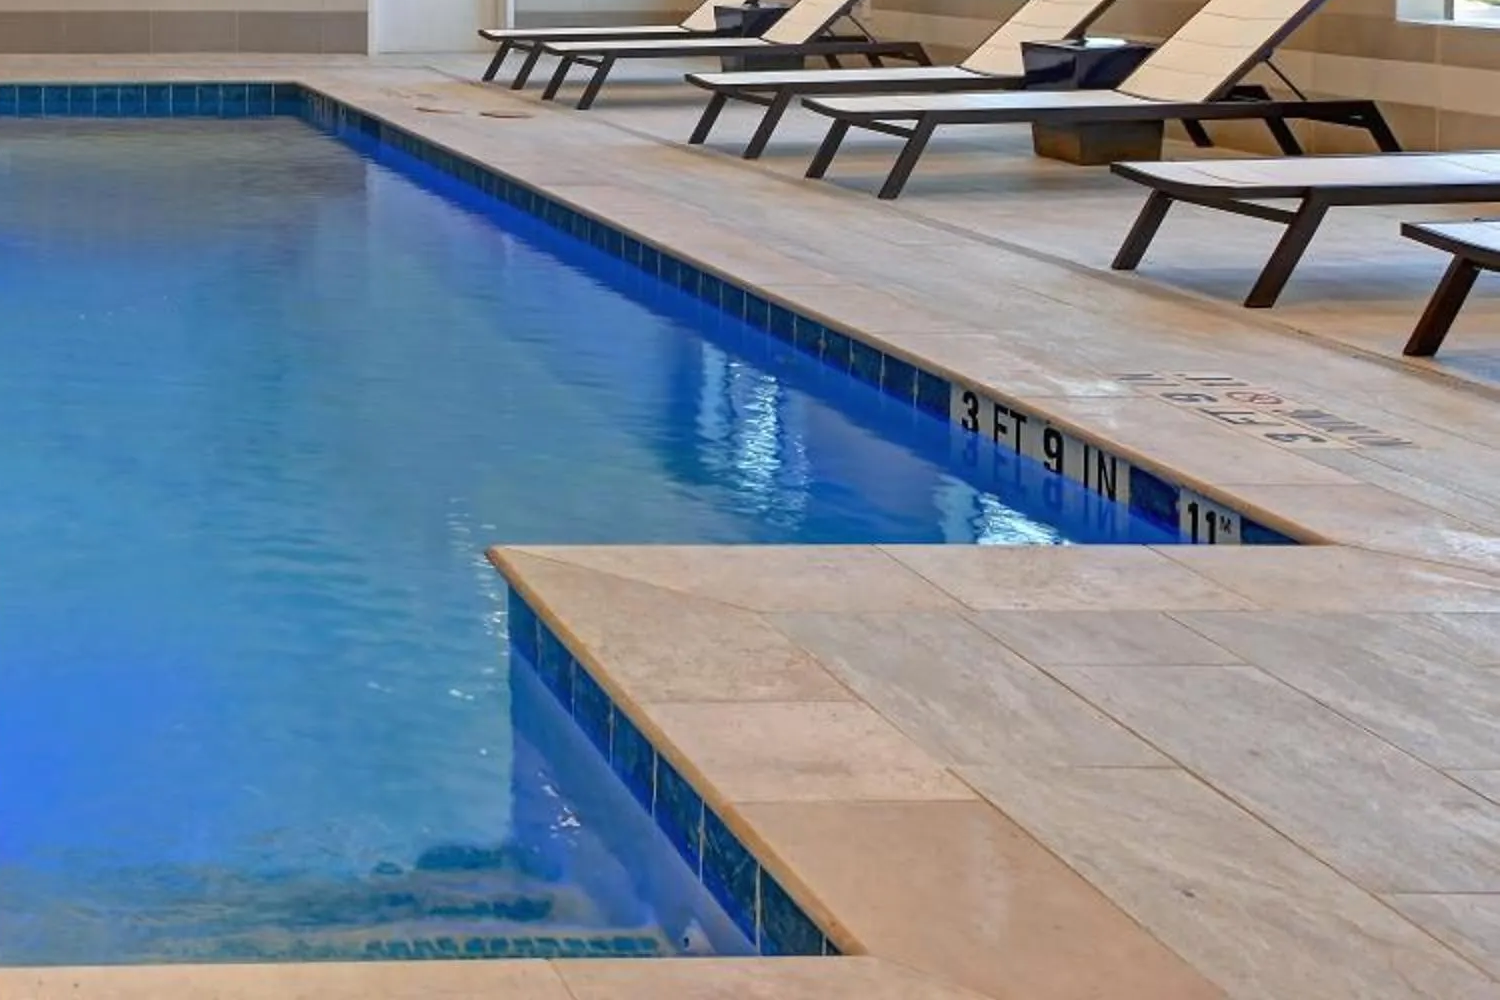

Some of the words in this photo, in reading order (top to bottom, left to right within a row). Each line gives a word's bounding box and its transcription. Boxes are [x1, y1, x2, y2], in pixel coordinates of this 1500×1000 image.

[961, 391, 980, 434] 3
[993, 403, 1028, 457] FT
[1043, 427, 1065, 475] 9
[1083, 443, 1118, 502] IN
